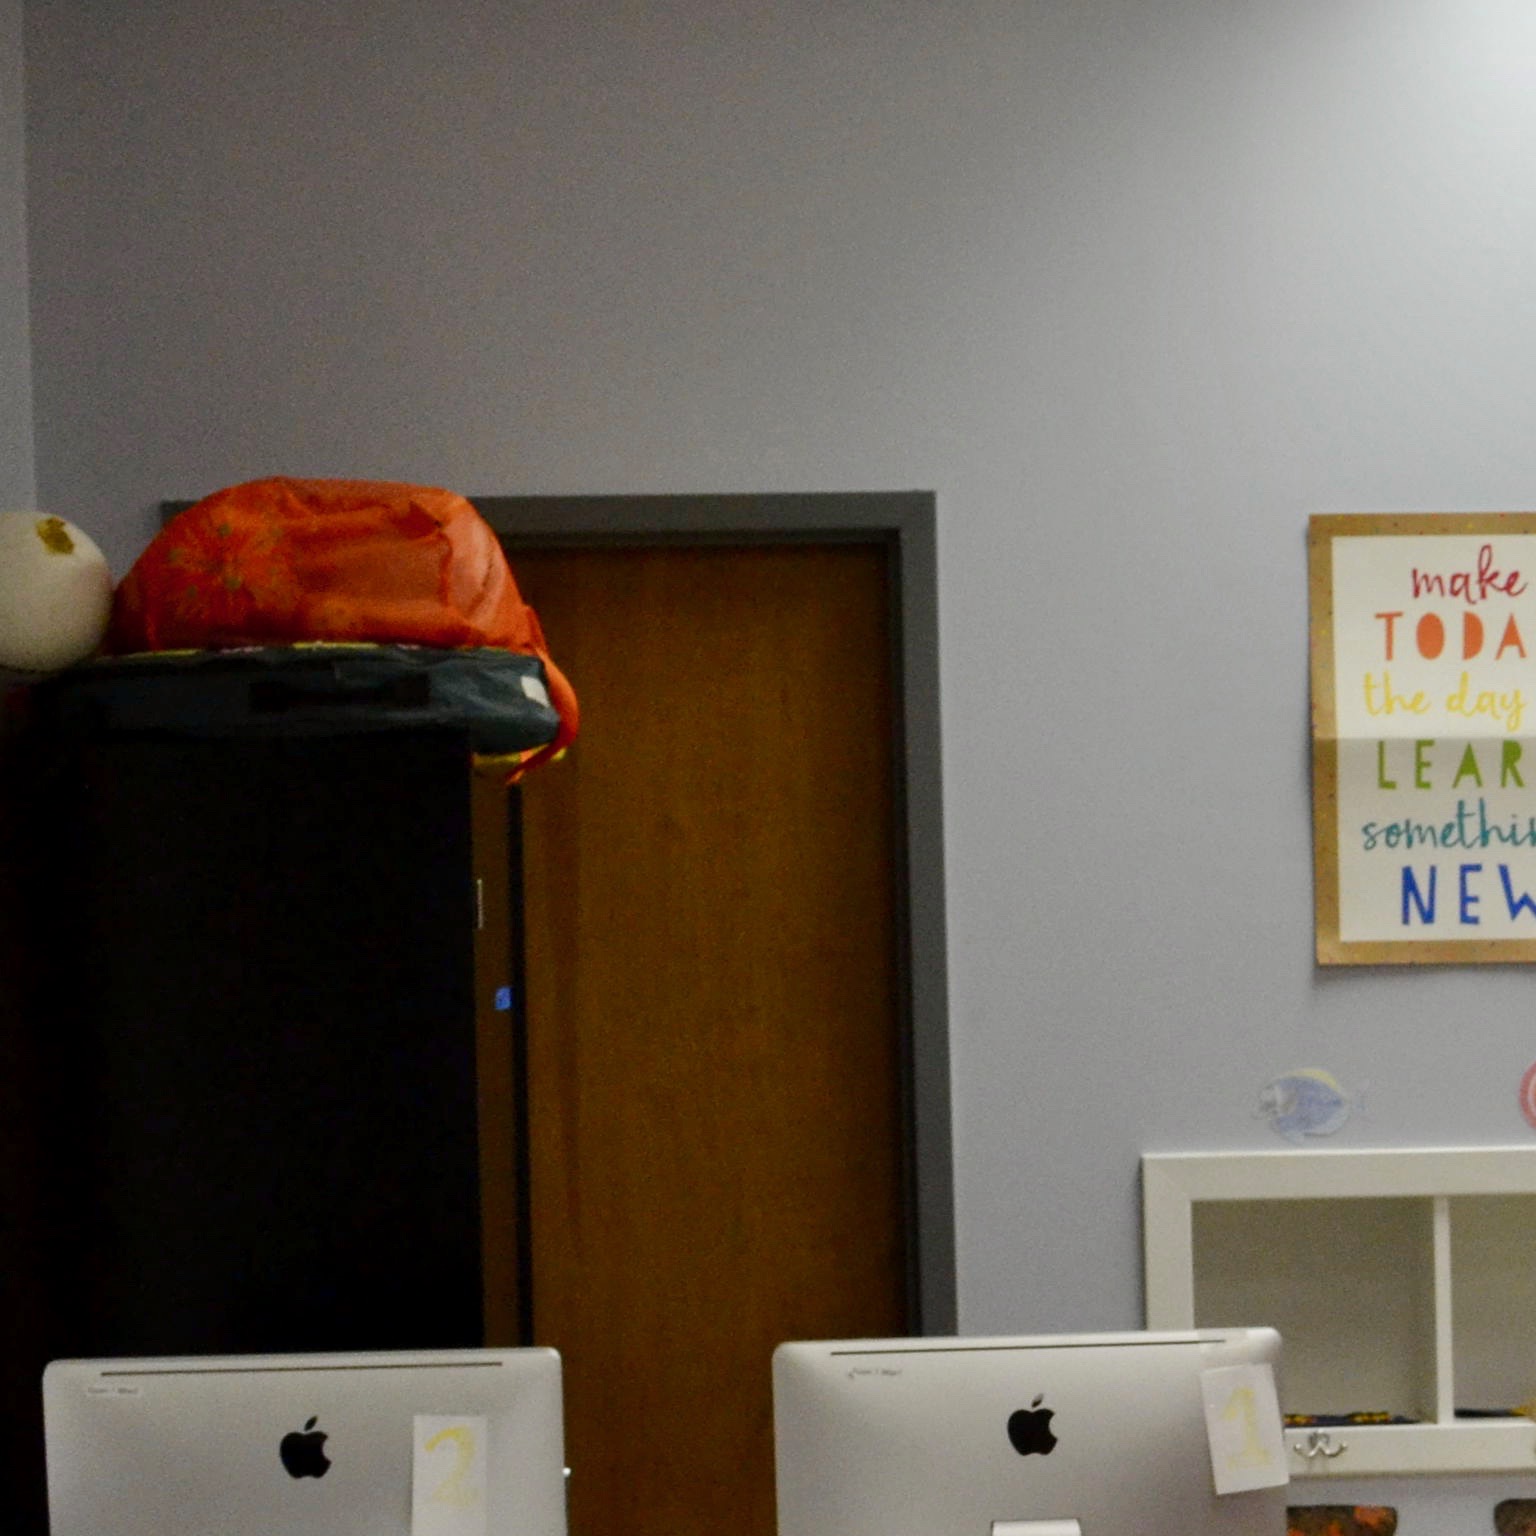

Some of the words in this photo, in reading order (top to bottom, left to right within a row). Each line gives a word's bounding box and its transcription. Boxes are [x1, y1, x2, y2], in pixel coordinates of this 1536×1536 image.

[1411, 543, 1528, 605] make
[1362, 671, 1431, 717] the
[1444, 671, 1528, 731] day
[1220, 1386, 1272, 1472] 1
[424, 1424, 479, 1510] 2
